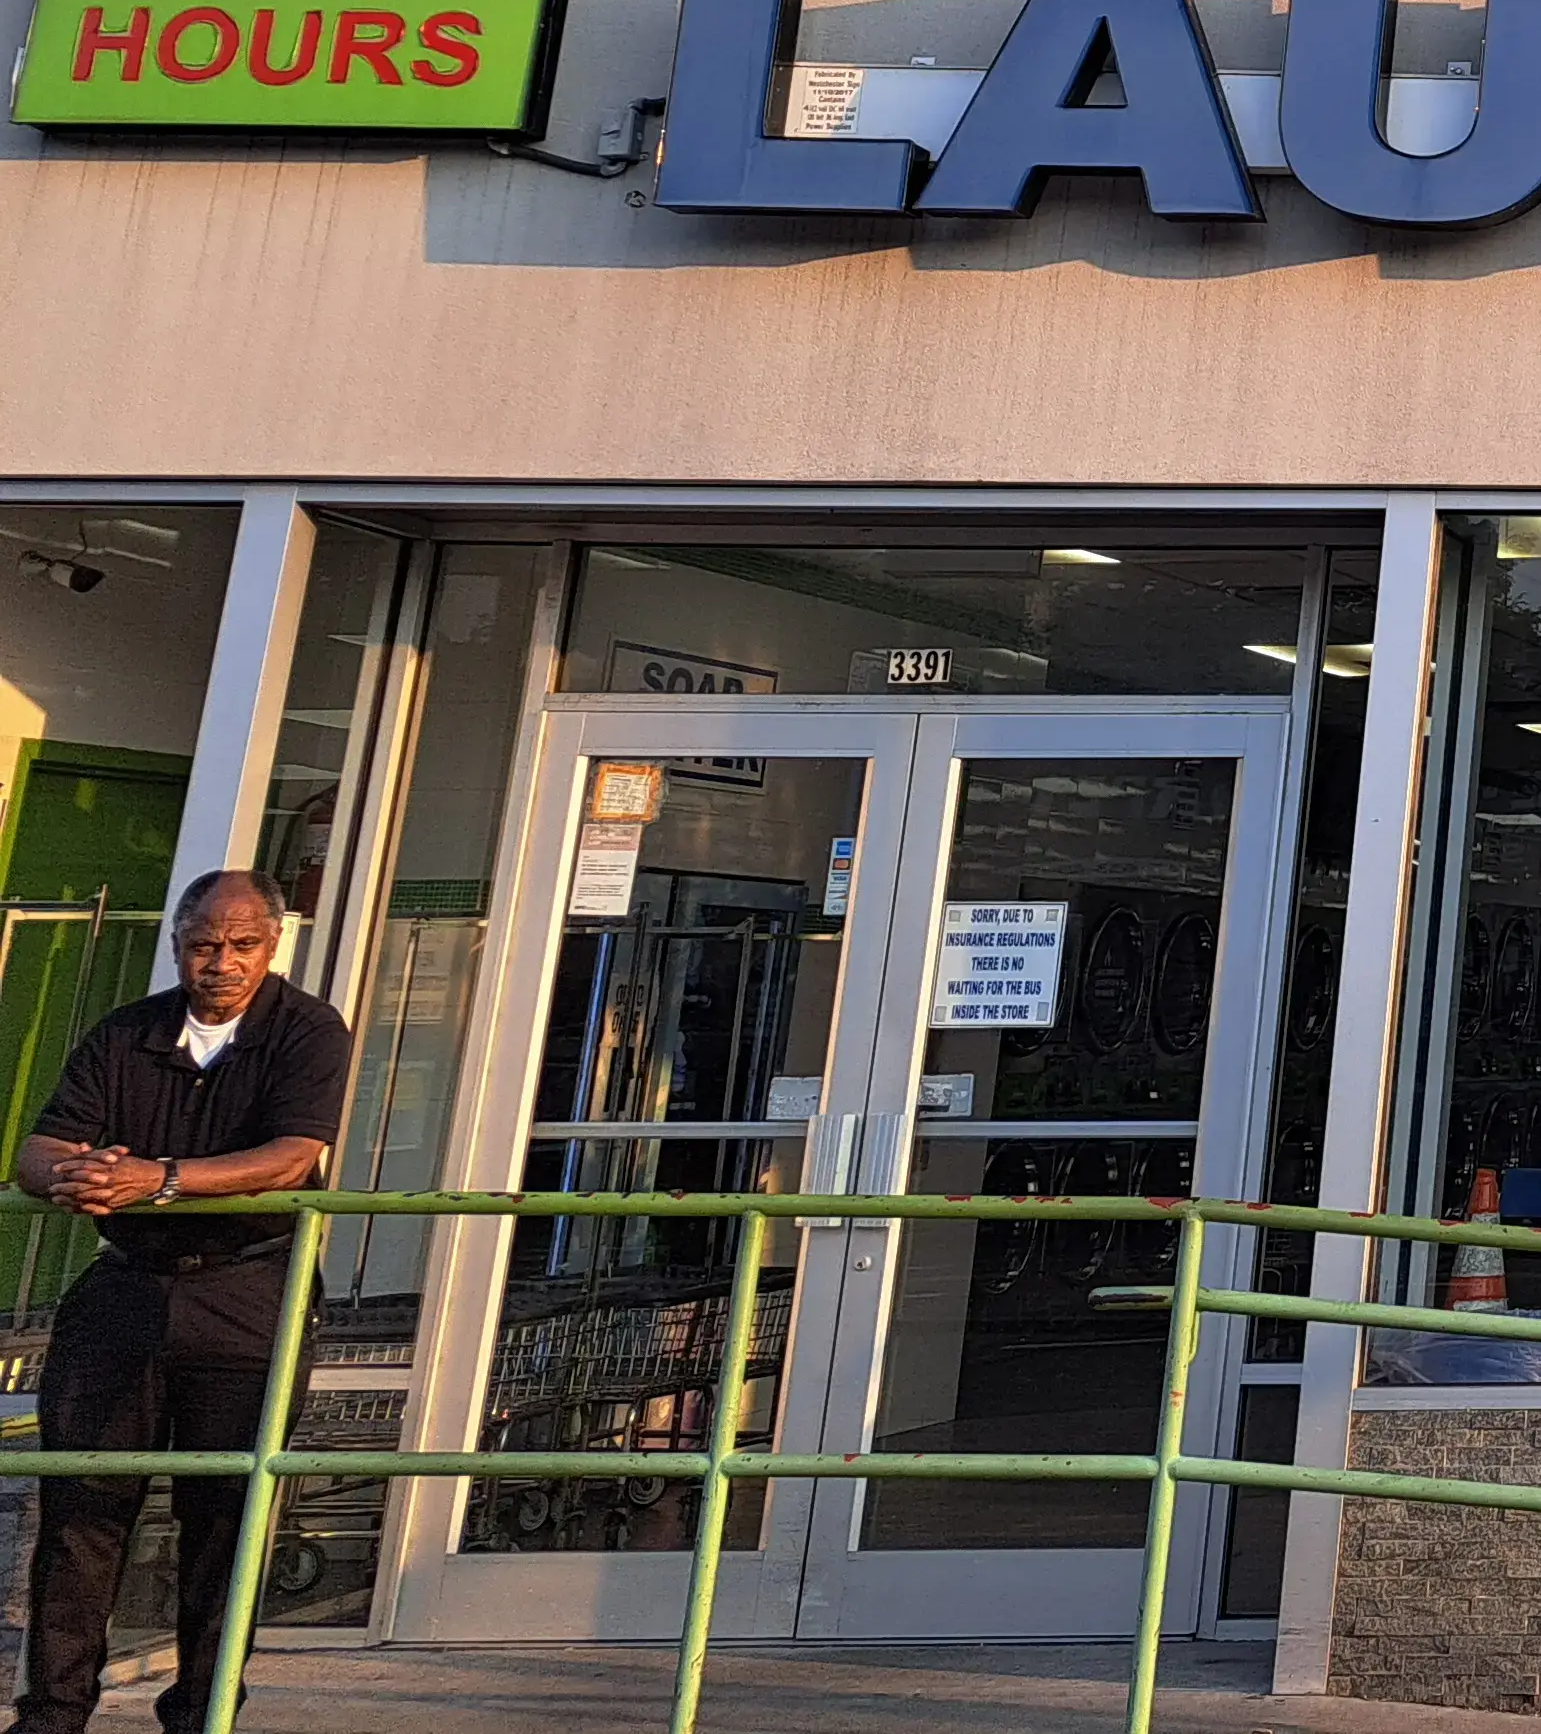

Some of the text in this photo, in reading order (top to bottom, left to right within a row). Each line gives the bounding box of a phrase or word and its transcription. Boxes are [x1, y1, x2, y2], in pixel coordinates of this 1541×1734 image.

[70, 6, 484, 87] HOURS
[890, 650, 950, 682] 3391
[970, 909, 1034, 926] SORRY, DUE TO
[945, 932, 1056, 947] INSURANCE REGULATIONS
[971, 956, 1025, 972] THERE IS NO
[947, 980, 1042, 995] WAITING FOR THE BUS
[951, 1004, 1030, 1020] INSIDE THE STORE
